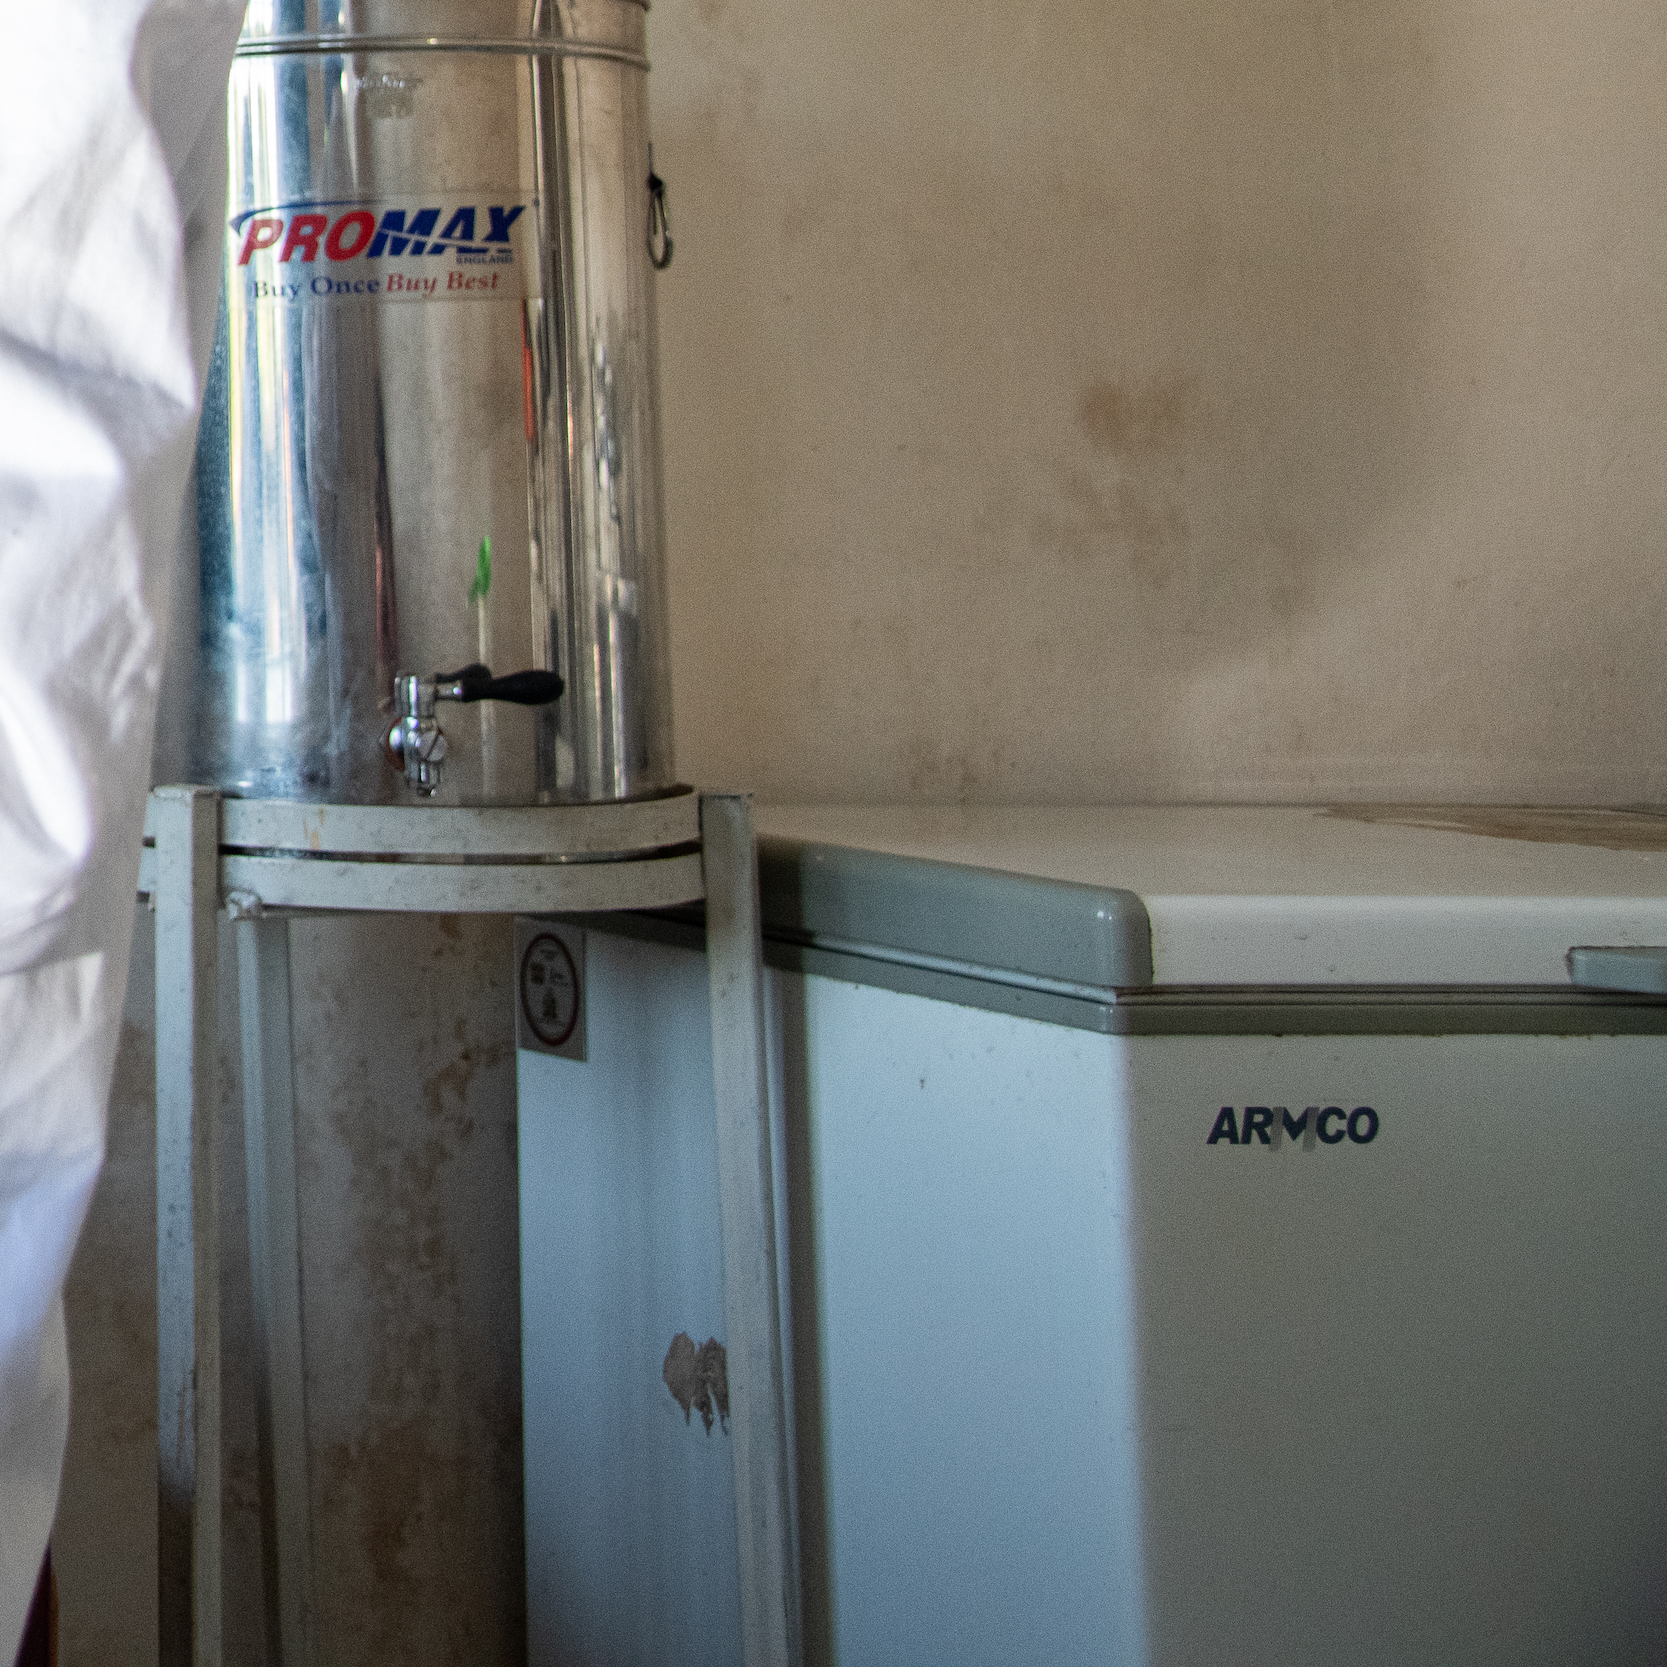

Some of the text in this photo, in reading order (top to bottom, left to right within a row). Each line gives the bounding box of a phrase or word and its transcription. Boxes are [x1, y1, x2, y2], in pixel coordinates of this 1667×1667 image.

[238, 205, 525, 266] PROMAX
[455, 254, 514, 265] ENGLAND
[252, 270, 500, 301] Buy Once Buy Best
[1205, 1105, 1380, 1152] ARMCO
